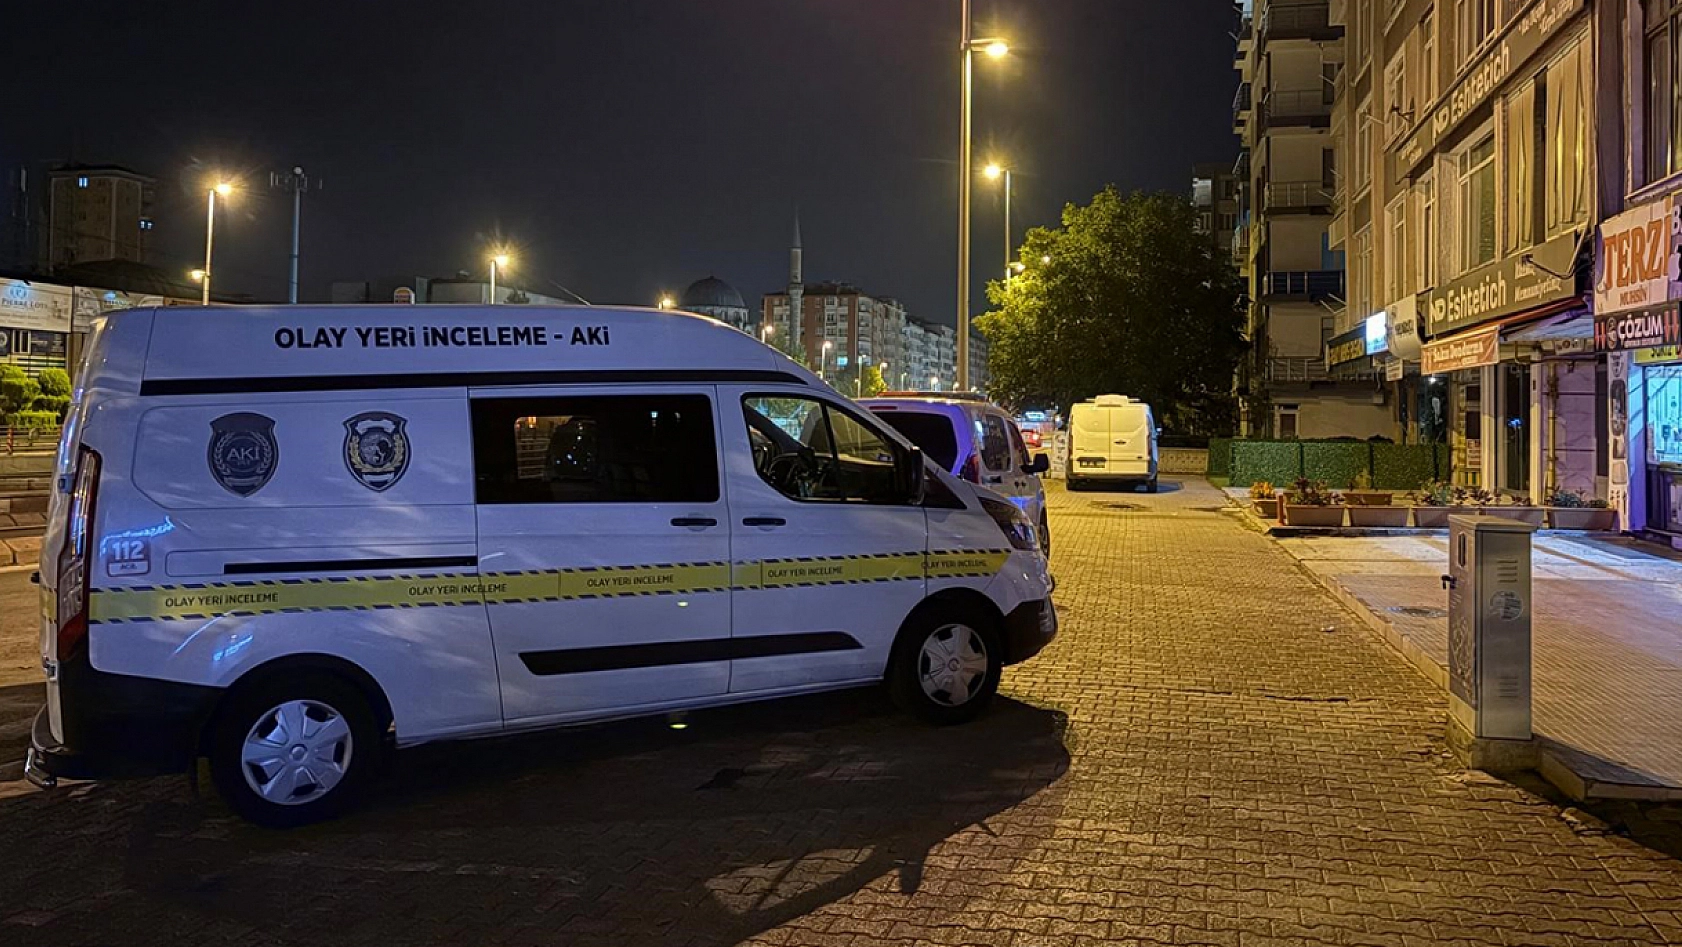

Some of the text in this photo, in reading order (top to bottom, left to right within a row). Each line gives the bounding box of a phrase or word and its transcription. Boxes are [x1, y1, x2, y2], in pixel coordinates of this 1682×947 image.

[1451, 40, 1509, 124] Eshtetich
[1447, 270, 1506, 323] Eshtetich
[274, 328, 347, 348] OLAY
[1617, 311, 1664, 346] ÇÖZÜM
[112, 540, 145, 560] 112
[586, 577, 610, 588] OLAY
[767, 569, 787, 578] OLAY
[408, 586, 435, 596] OLAY
[165, 596, 195, 608] OLAY
